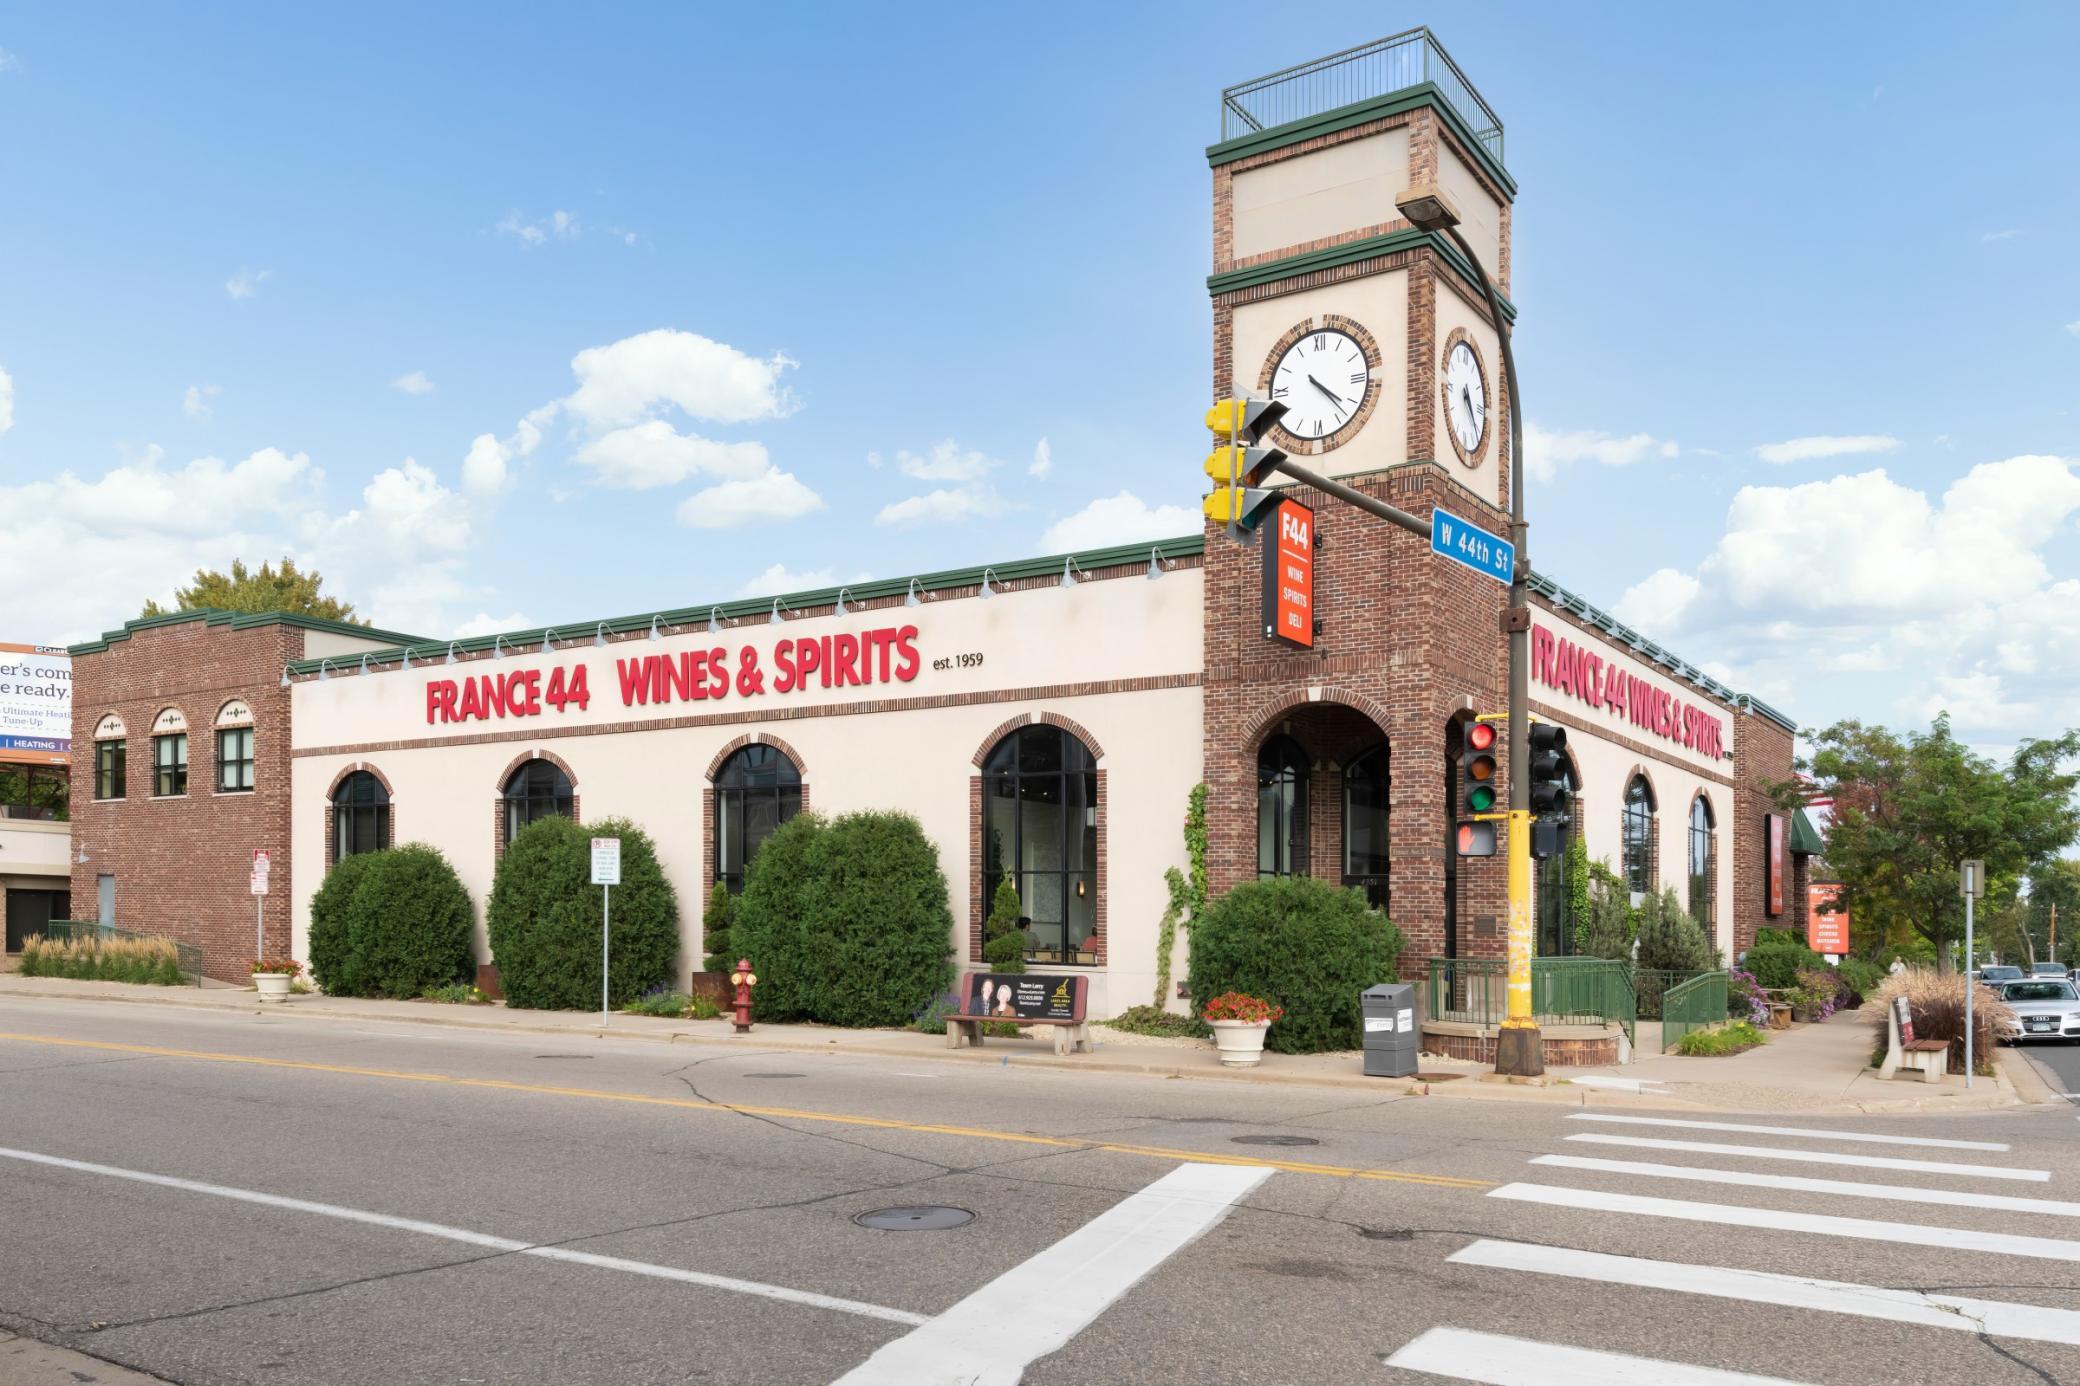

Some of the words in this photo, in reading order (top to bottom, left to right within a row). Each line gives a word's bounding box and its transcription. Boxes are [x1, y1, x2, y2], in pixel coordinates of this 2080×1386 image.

[1282, 512, 1308, 550] F44
[1442, 522, 1452, 546] W
[1458, 532, 1489, 564] 44th
[1495, 547, 1508, 572] St
[1287, 565, 1304, 584] WINE
[1283, 586, 1307, 608] SPIRITS
[1288, 612, 1302, 629] DELI
[933, 656, 953, 670] est.
[955, 652, 983, 668] 1959
[427, 669, 541, 725] FRANCE
[545, 664, 591, 713] 44
[616, 647, 730, 706] WINES
[736, 645, 765, 697] &
[773, 624, 920, 693] SPIRITS
[15, 684, 70, 700] ready.
[1532, 623, 1603, 709] FRANCE
[1604, 663, 1628, 720] 44
[1628, 673, 1671, 740] WINES
[1671, 699, 1682, 745] &
[1683, 703, 1723, 762] SPIRITS
[3, 707, 44, 718] Ultimate
[3, 716, 43, 727] Tune-Up
[14, 740, 55, 750] HEATING
